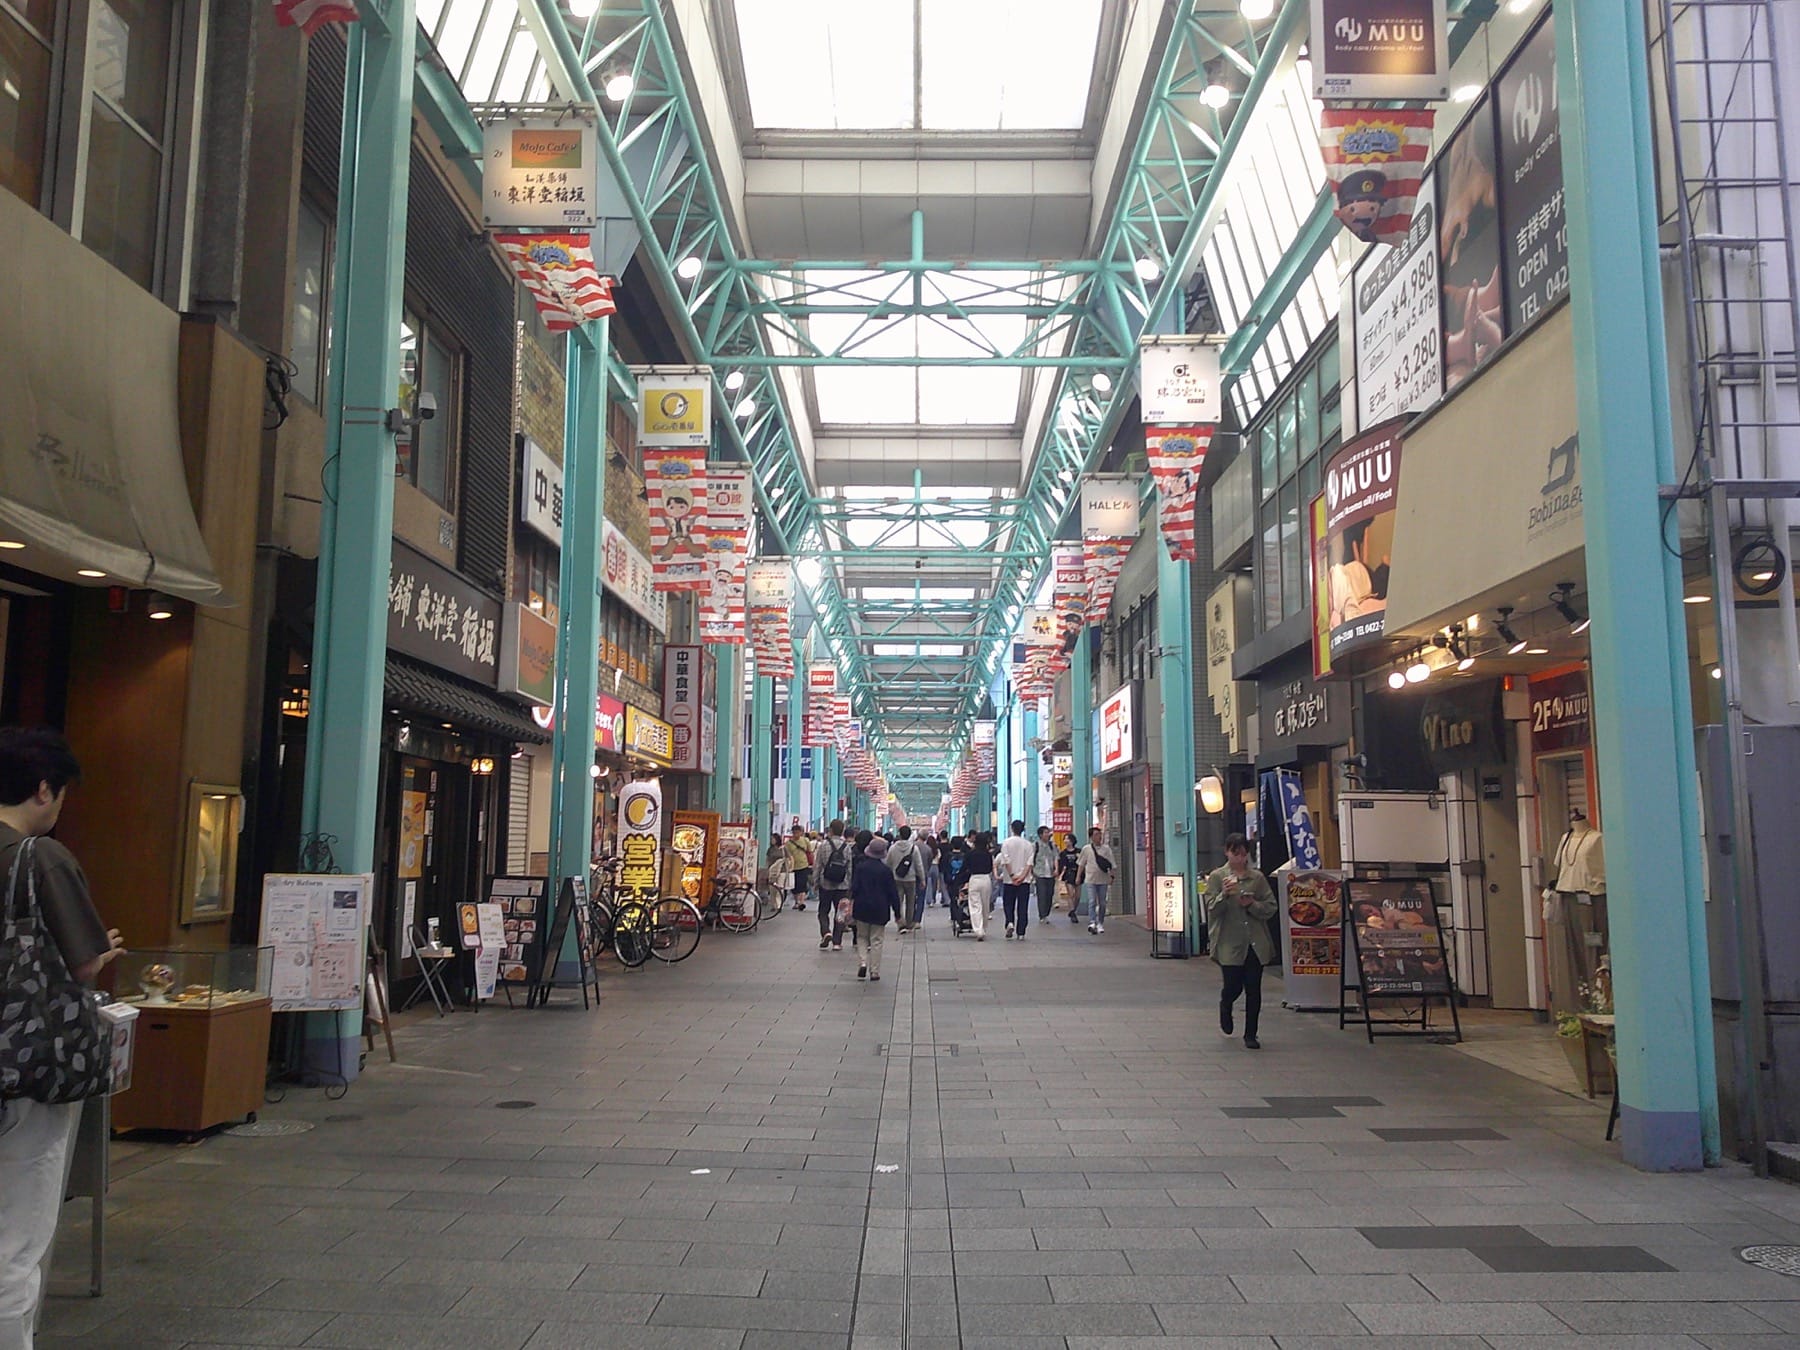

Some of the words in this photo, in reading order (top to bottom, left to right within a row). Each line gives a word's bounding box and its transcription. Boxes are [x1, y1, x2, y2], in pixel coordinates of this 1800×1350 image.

[1368, 24, 1424, 41] MUU
[508, 185, 585, 204] 東洋堂稲垣
[1516, 186, 1567, 257] 吉祥寺サ
[1518, 243, 1549, 289] OPEN
[1519, 292, 1541, 324] TEL
[1341, 449, 1392, 501] MUU
[1088, 500, 1133, 510] HALビル
[1533, 699, 1552, 733] 2F
[1565, 697, 1588, 717] MUU
[1423, 714, 1473, 752] Vino
[1397, 901, 1423, 910] MUU
